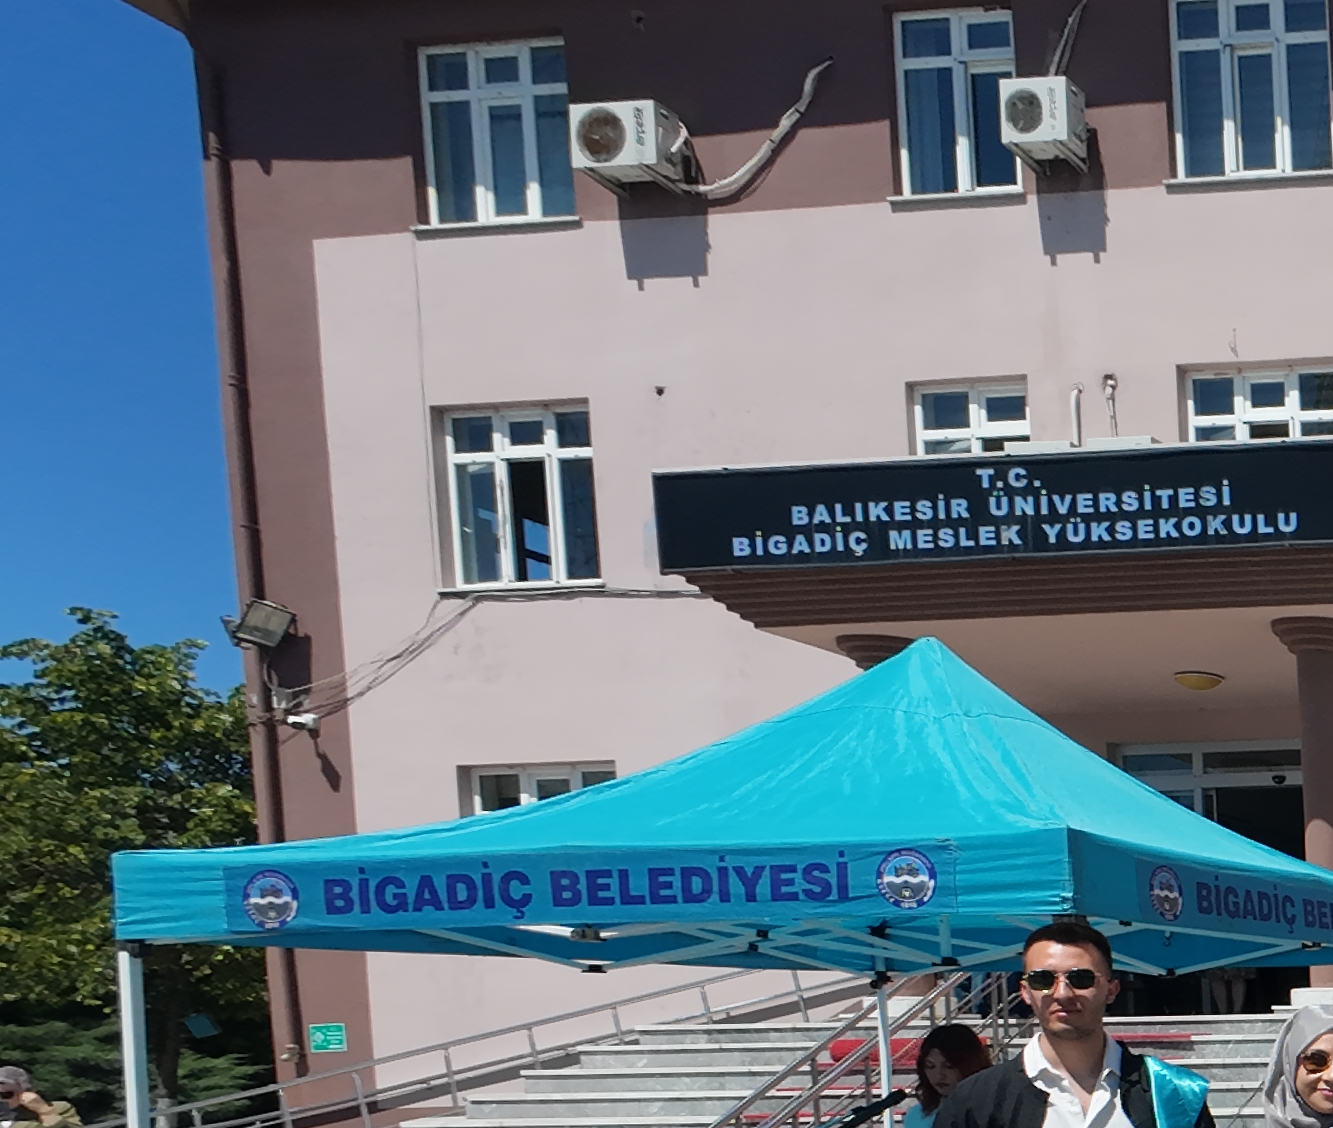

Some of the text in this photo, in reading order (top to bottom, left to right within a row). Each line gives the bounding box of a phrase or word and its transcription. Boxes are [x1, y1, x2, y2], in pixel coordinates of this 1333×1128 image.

[790, 478, 1232, 526] BALIKESİR ÜNİVERSİTESİ
[975, 467, 1042, 489] T.C.
[731, 511, 1298, 557] BİGADİÇ MESLEK YÜKSEKOKULU
[322, 860, 534, 920] BİGADİÇ
[549, 849, 850, 908] BELEDİYESİ
[1195, 874, 1297, 934] BİGADİÇ
